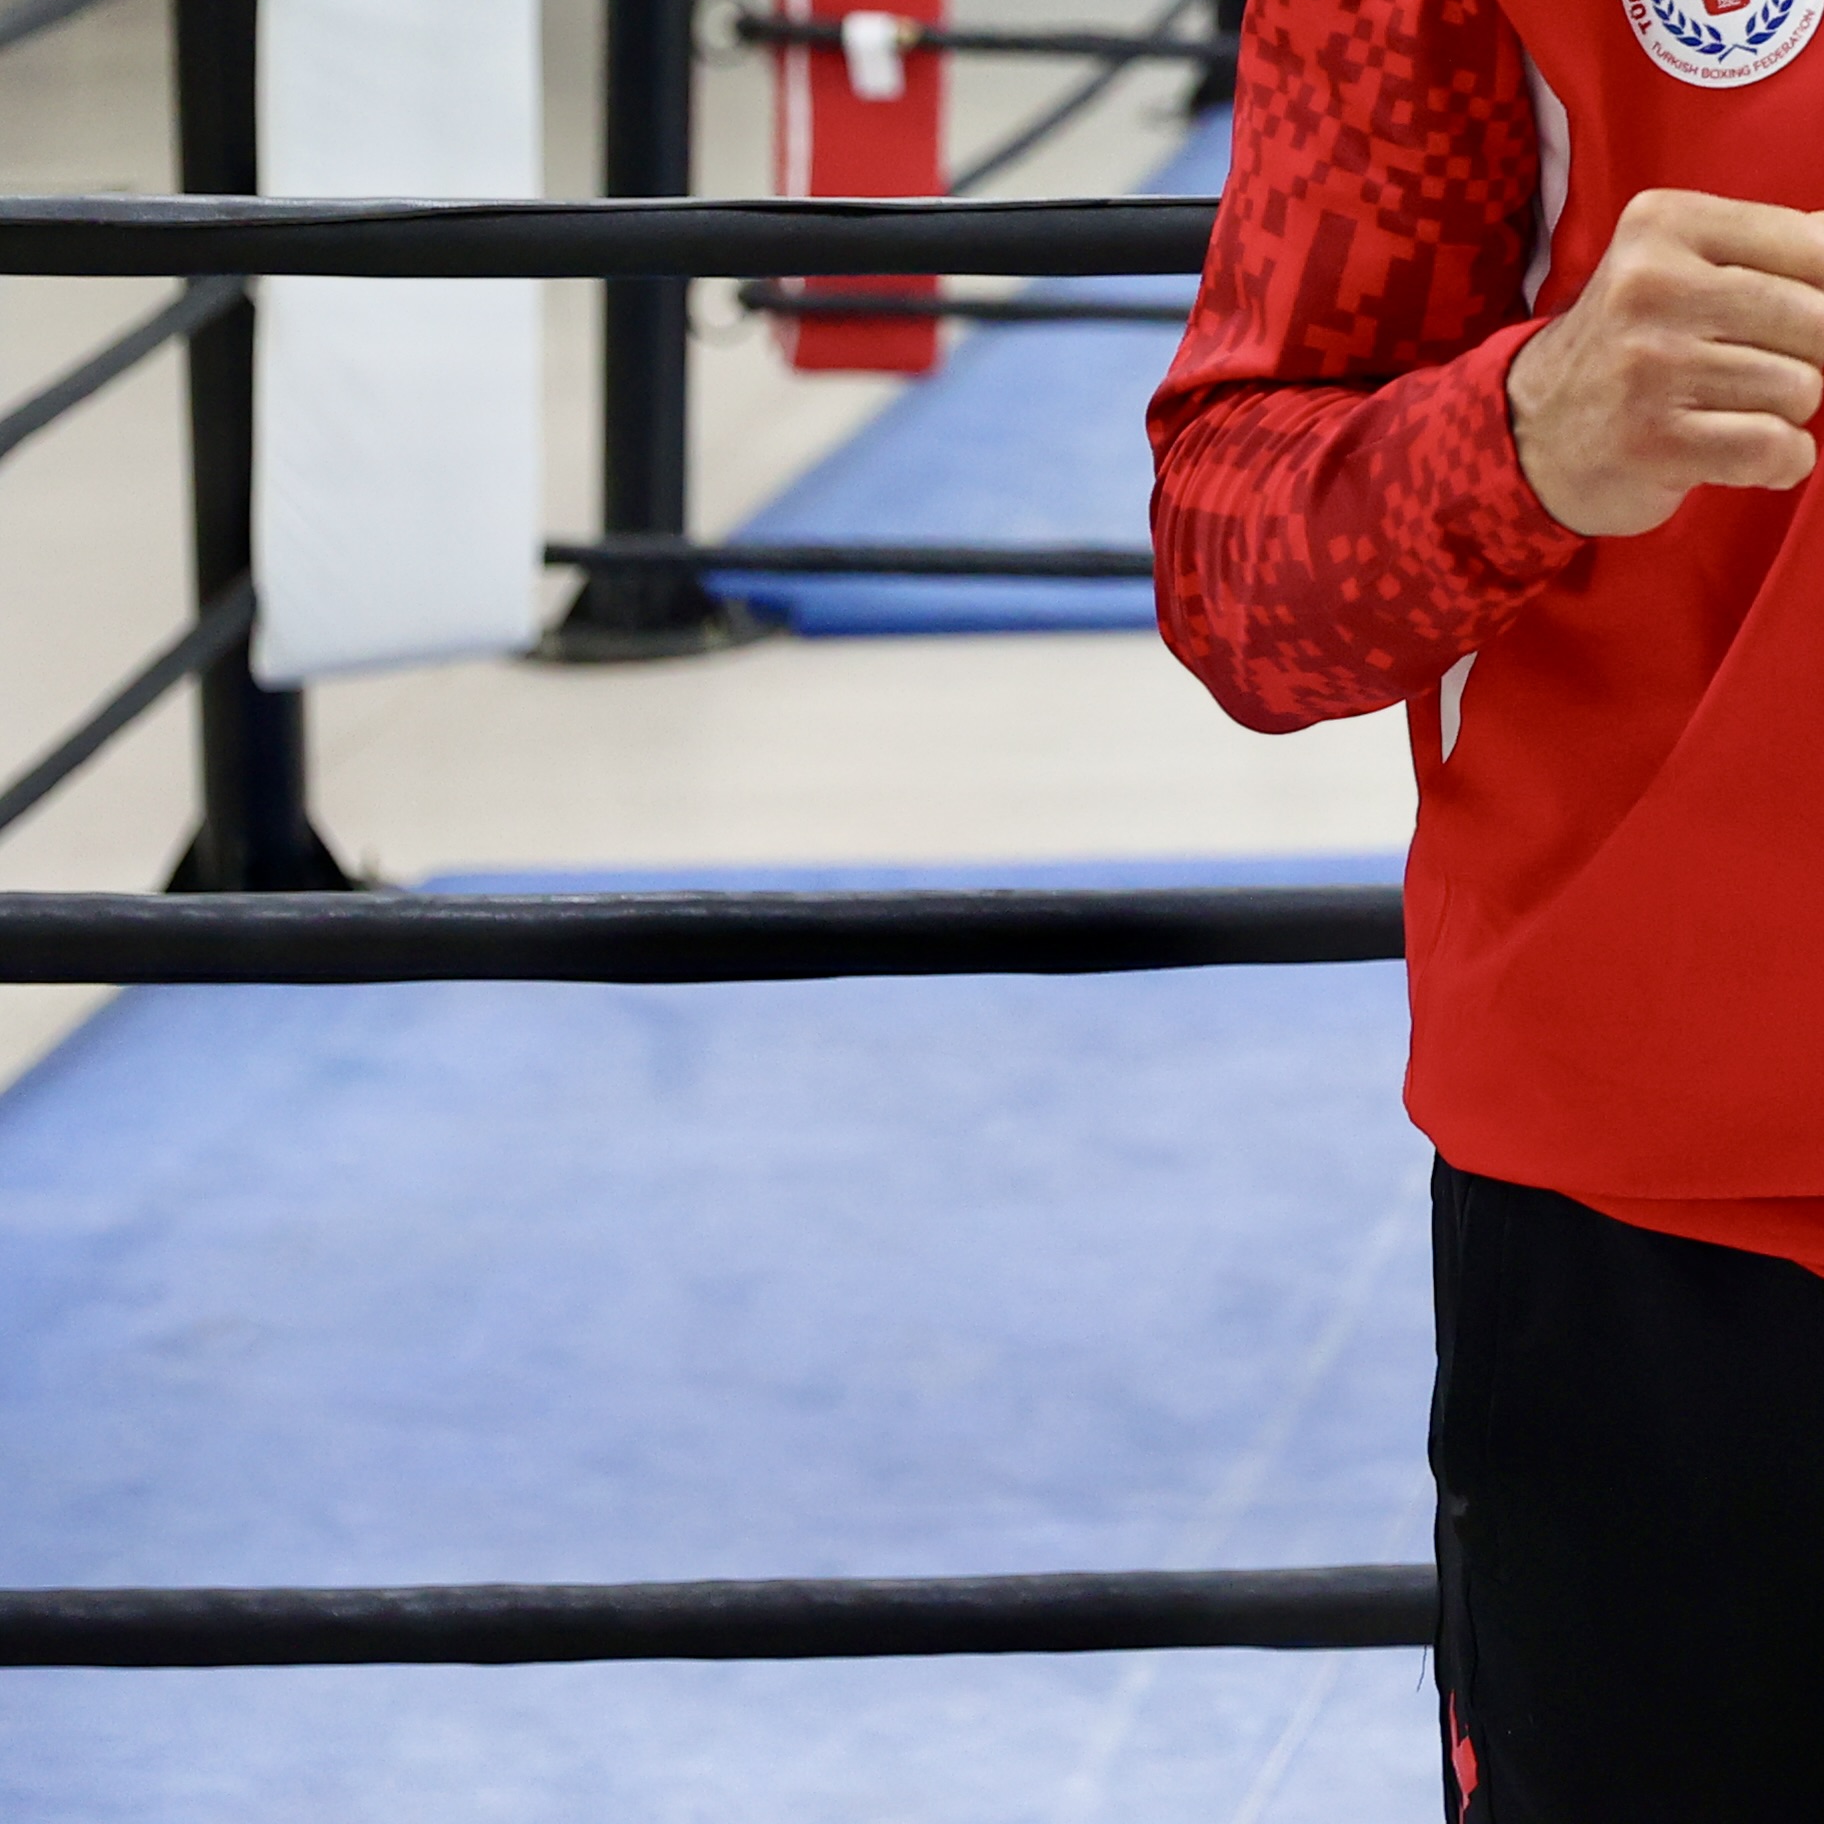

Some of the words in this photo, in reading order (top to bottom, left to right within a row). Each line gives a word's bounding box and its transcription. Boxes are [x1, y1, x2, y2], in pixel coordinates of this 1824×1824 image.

[1651, 40, 1699, 76] TURKISH
[1701, 64, 1751, 80] BOXING
[1754, 8, 1817, 72] FEDERATION
